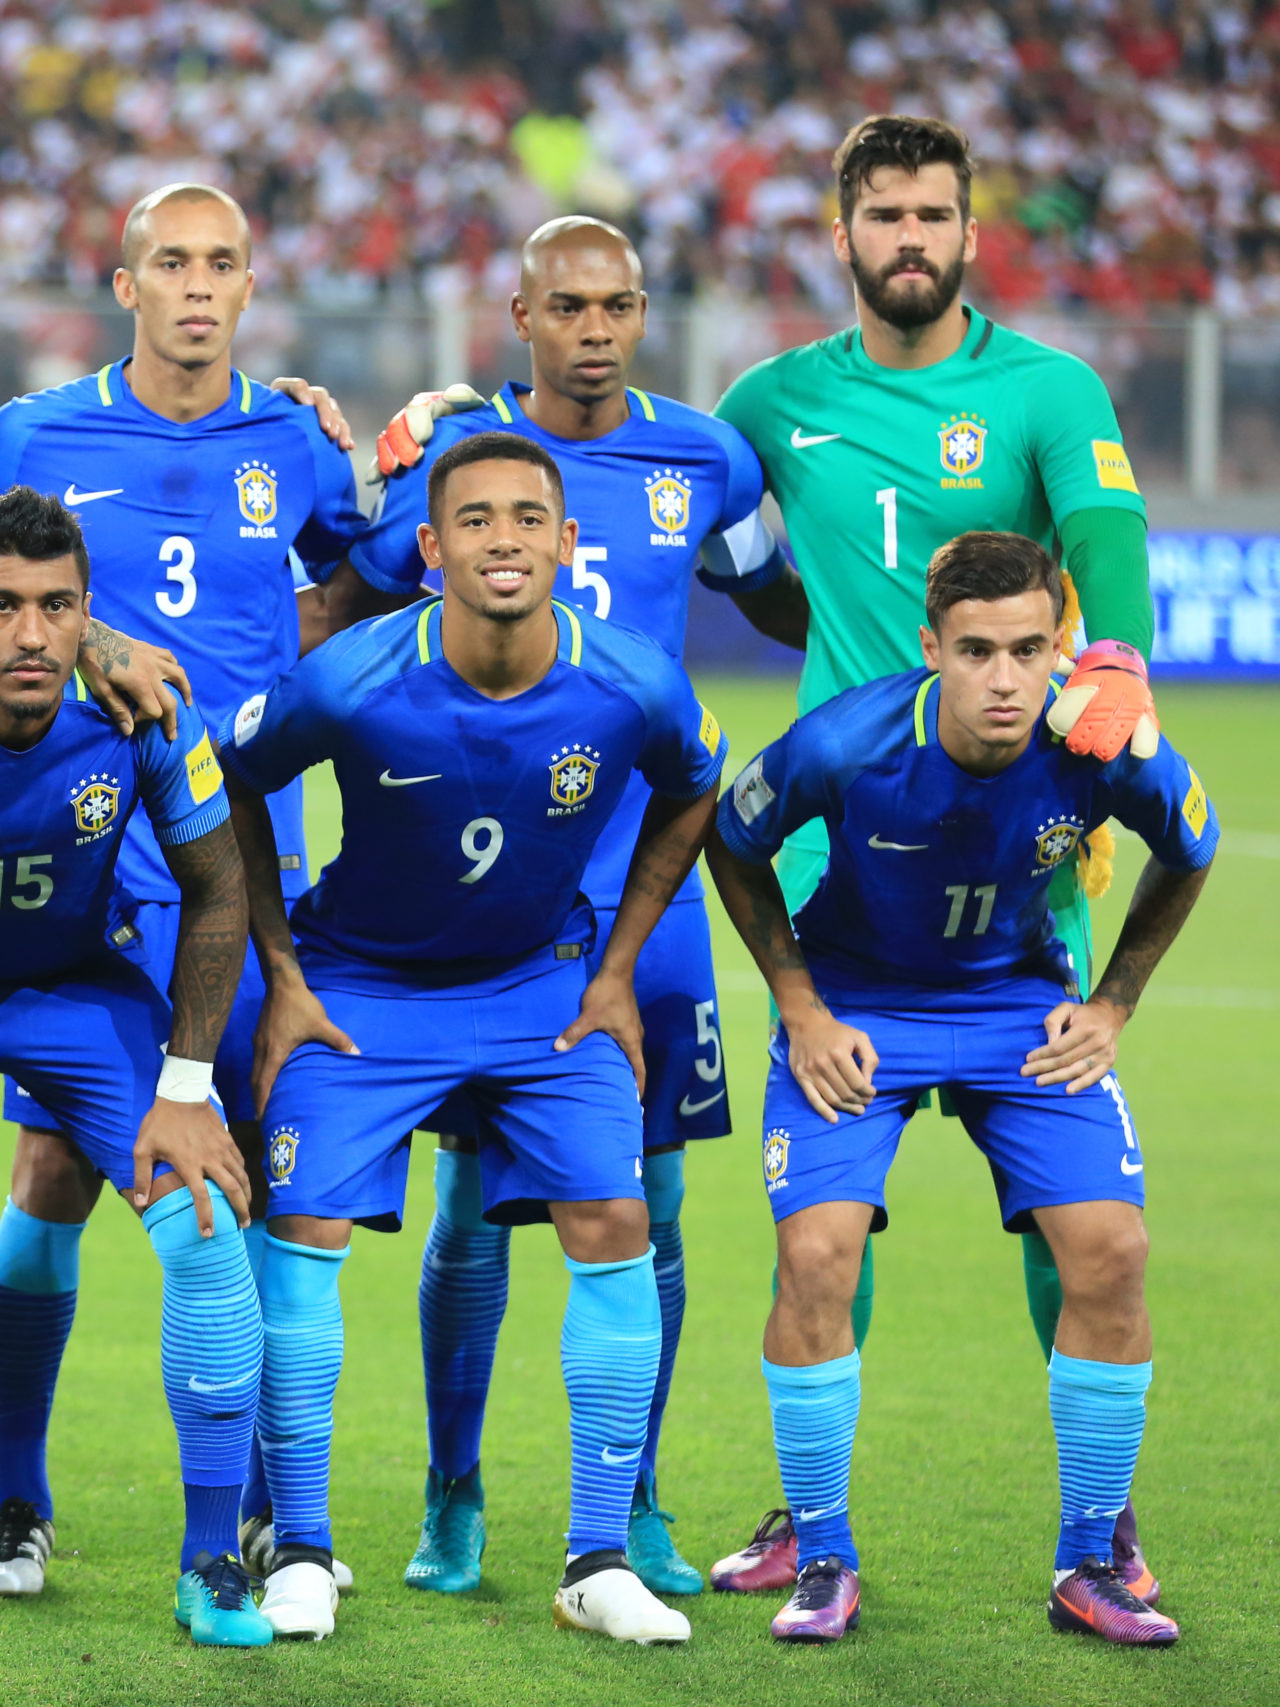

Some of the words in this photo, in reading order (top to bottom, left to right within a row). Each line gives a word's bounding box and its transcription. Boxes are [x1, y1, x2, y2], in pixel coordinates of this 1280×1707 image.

[941, 478, 984, 489] BRASIL
[240, 526, 278, 538] BRASIL
[650, 533, 688, 546] BRASIL
[876, 487, 898, 569] 1
[155, 535, 197, 618] 3
[572, 546, 611, 621] 5
[191, 756, 211, 777] FIFA
[76, 825, 114, 847] BRASIL
[458, 816, 504, 884] 9
[943, 884, 998, 938] 11
[694, 1000, 721, 1082] 5
